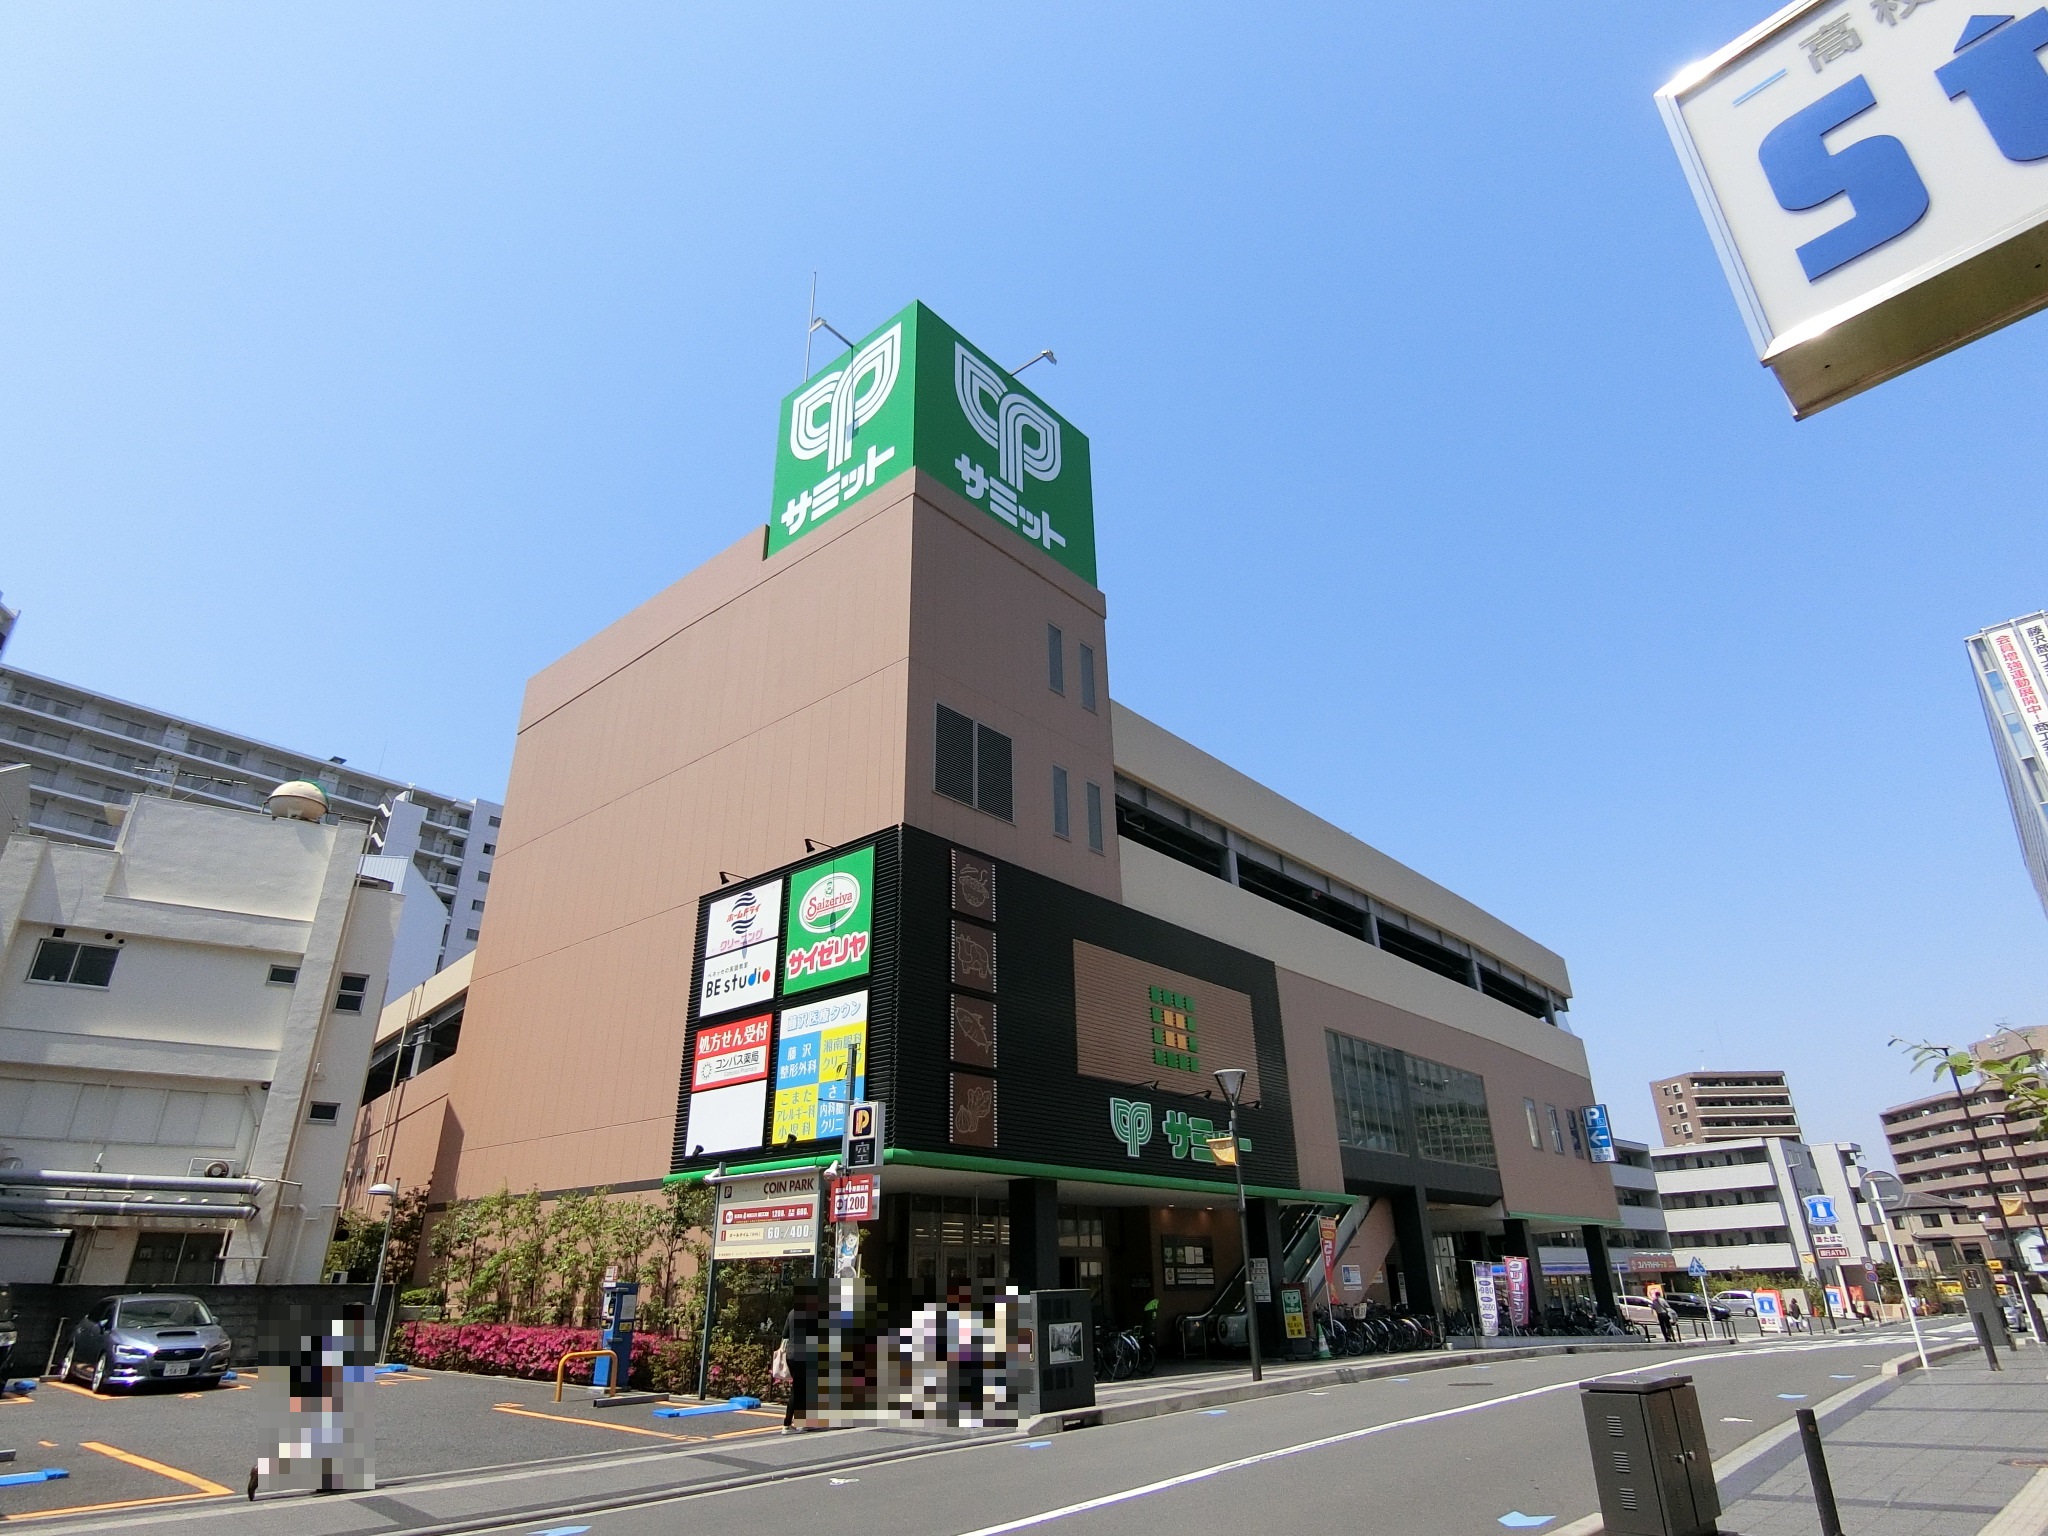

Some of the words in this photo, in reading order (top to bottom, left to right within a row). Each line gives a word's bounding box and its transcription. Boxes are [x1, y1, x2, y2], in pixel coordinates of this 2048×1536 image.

[781, 445, 895, 537] サミット
[954, 453, 1066, 550] サミット
[806, 891, 853, 920] Saizeriya
[719, 928, 764, 952] クリーニング
[788, 934, 867, 976] サイゼリヤ
[706, 978, 721, 999] BE
[724, 967, 771, 993] studio
[787, 1001, 862, 1032] 藤沢医療タウン
[698, 1020, 768, 1055] 処方せん受付
[780, 1058, 817, 1080] 整形外科
[782, 1089, 812, 1106] こまた
[776, 1105, 816, 1123] アレルギー科
[855, 1109, 870, 1134] P
[1585, 1108, 1600, 1126] P
[1162, 1110, 1252, 1163] サミ
[854, 1141, 870, 1164] 空
[763, 1180, 787, 1194] COIN
[789, 1178, 815, 1192] PARK
[844, 1196, 866, 1212] 1,200
